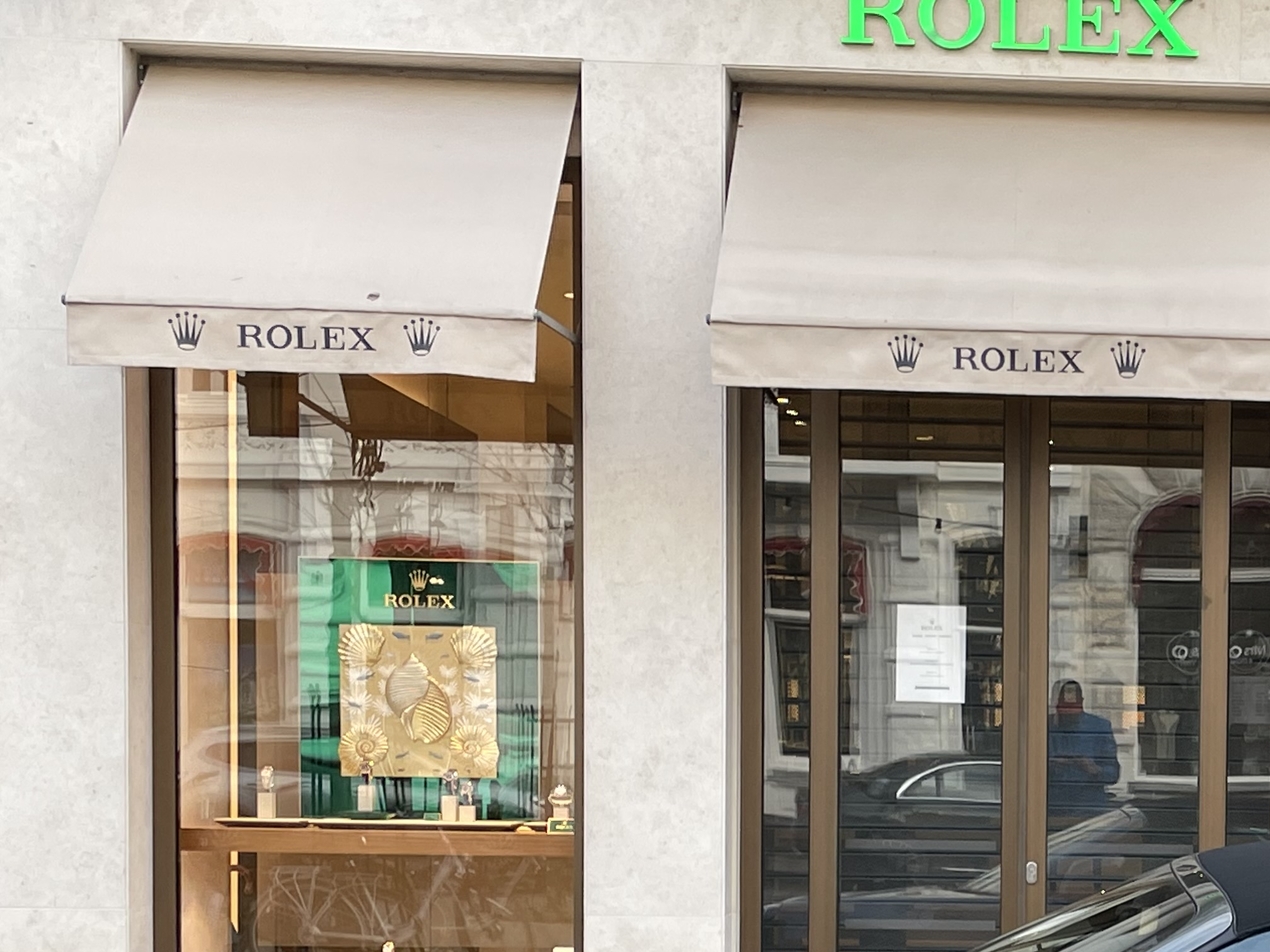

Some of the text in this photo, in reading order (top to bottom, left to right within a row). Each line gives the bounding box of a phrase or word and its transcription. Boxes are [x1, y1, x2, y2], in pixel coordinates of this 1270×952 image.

[840, 0, 1199, 57] ROLEX
[236, 323, 377, 352] ROLEX
[952, 346, 1085, 374] ROLEX
[383, 593, 456, 610] ROLEX
